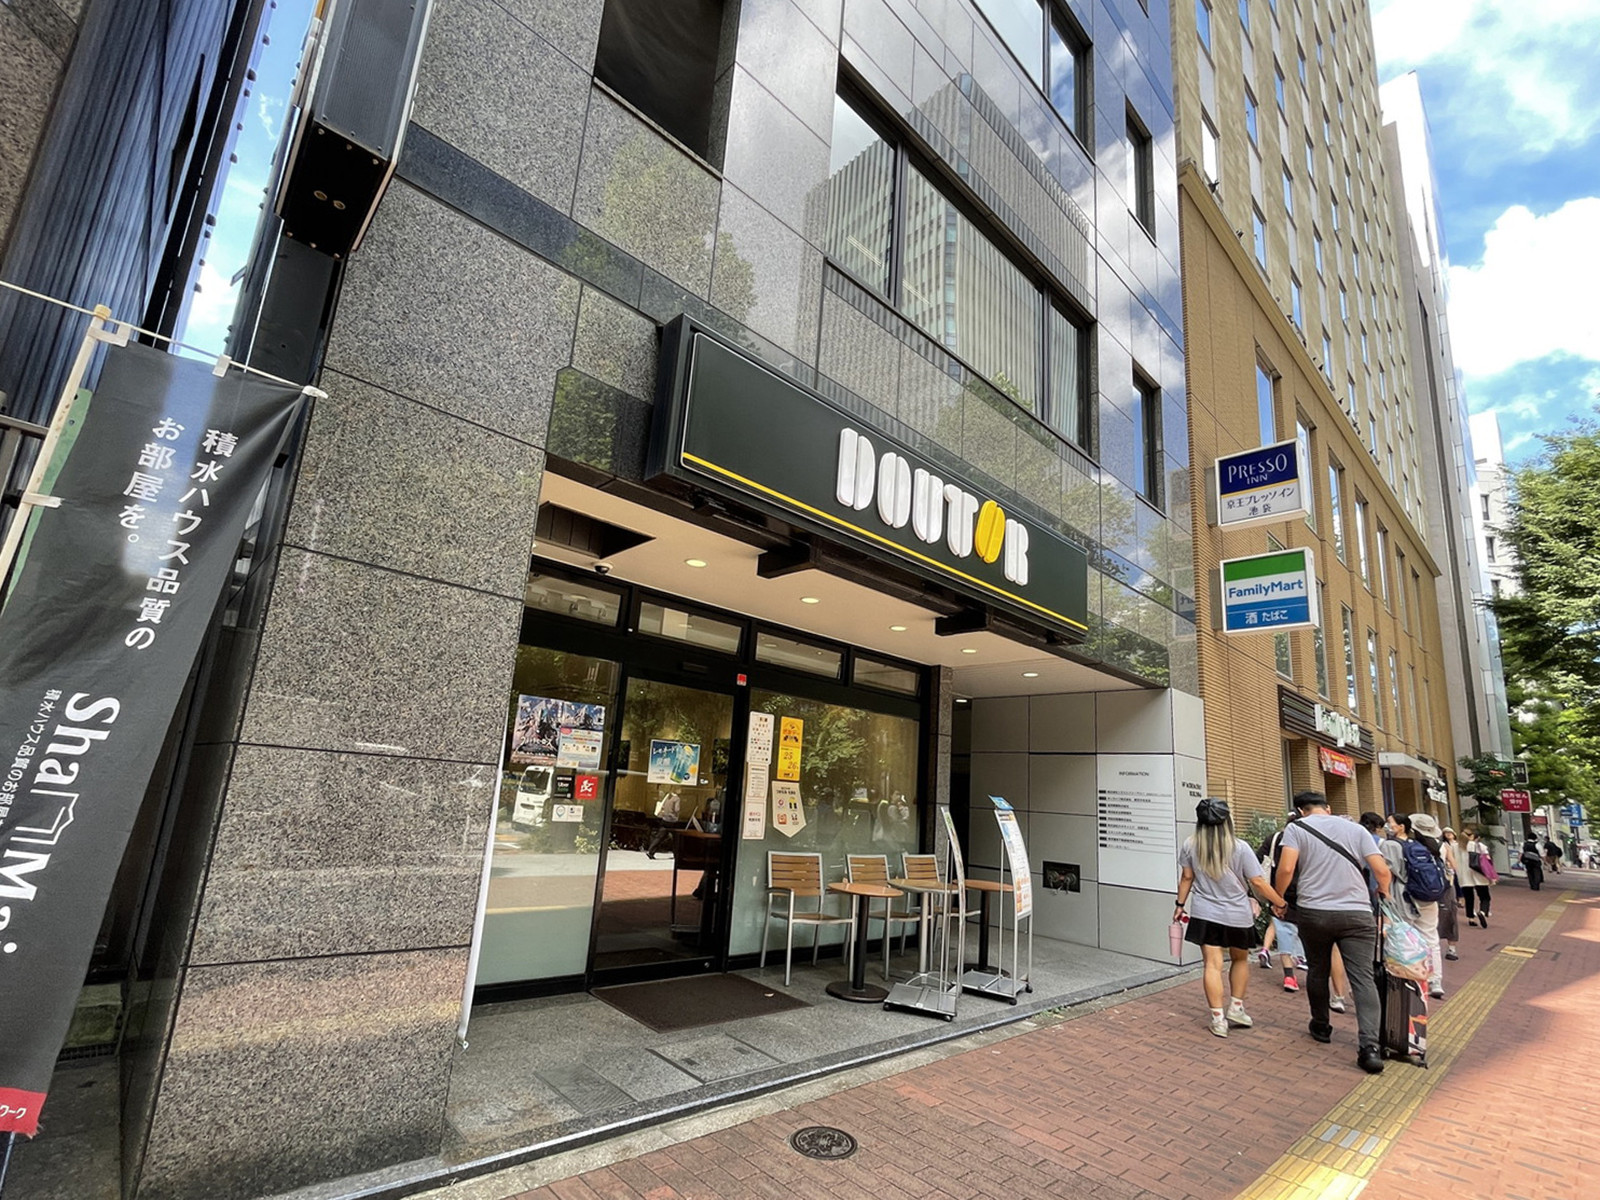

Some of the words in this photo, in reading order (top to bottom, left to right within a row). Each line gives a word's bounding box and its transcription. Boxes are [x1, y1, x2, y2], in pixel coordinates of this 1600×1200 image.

[118, 416, 186, 544] お部屋を。
[1228, 453, 1288, 483] PRESSO
[1246, 473, 1269, 485] INN
[835, 427, 1030, 586] DOUTOR
[1226, 487, 1295, 510] 京王プレッソイン
[124, 428, 239, 650] 積水ハウス品質の
[1228, 578, 1304, 599] FamilyMart
[1245, 612, 1258, 625] 酒
[1261, 609, 1289, 622] たばこ
